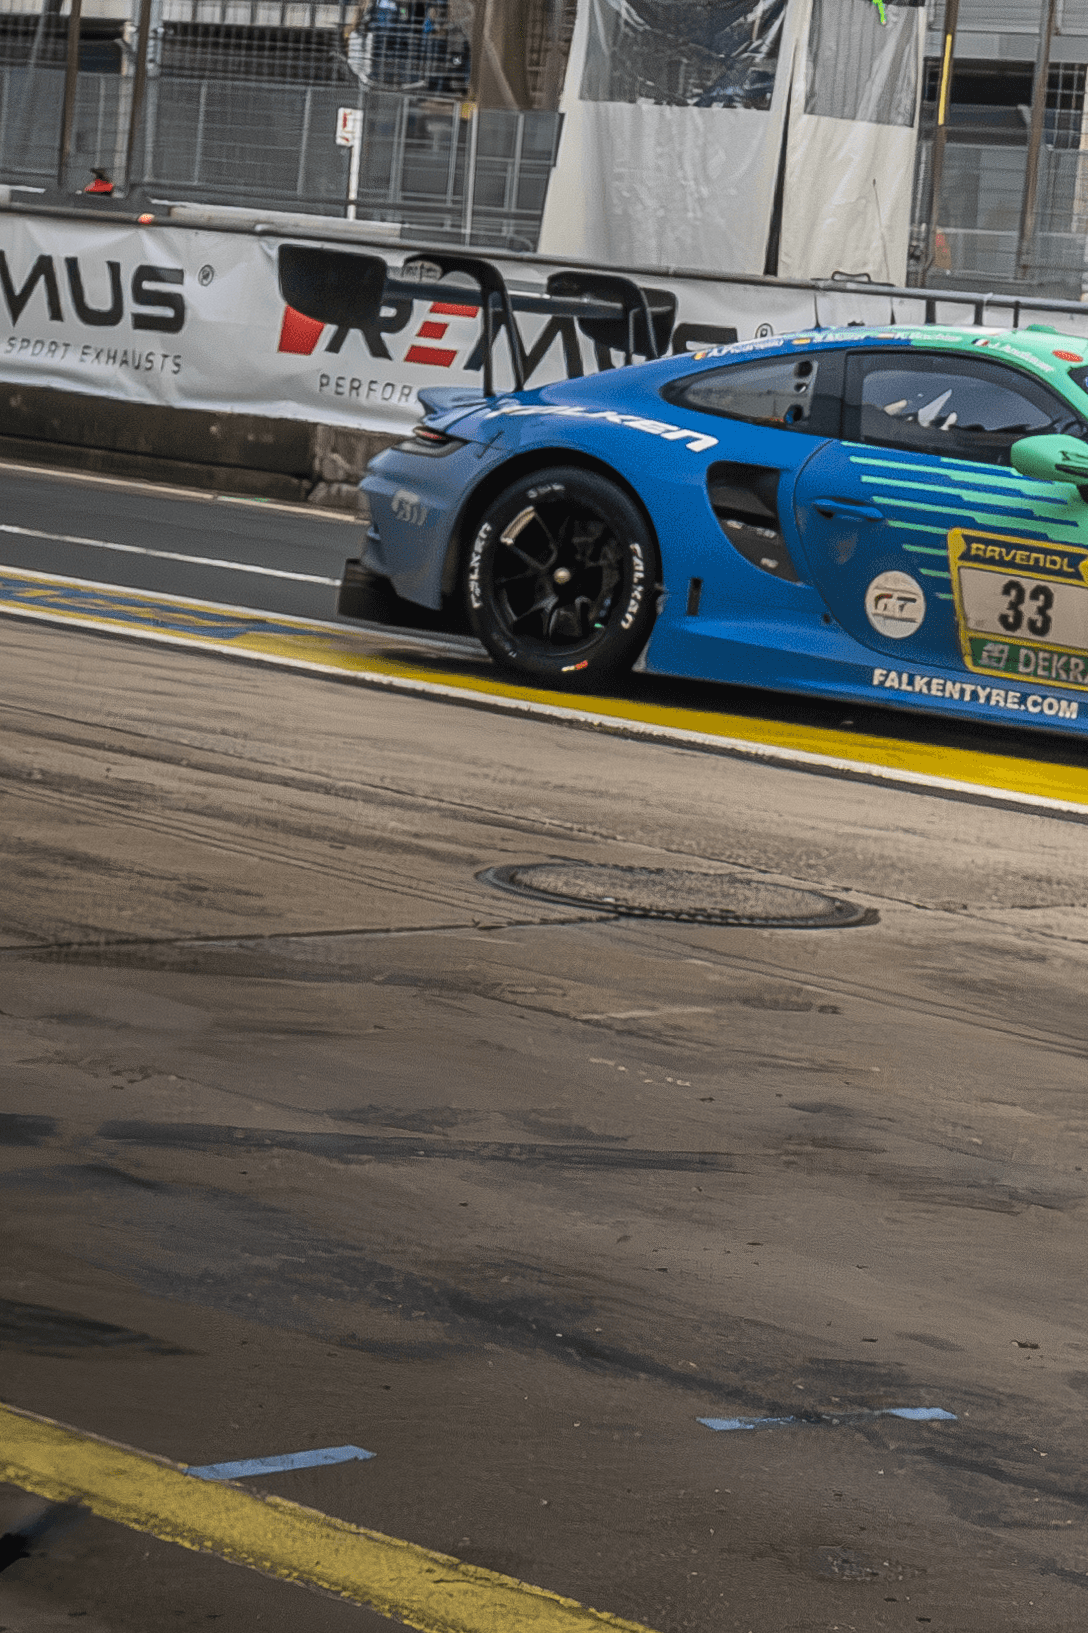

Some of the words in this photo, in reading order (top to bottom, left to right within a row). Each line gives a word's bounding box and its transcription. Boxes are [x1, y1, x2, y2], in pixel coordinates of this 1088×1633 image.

[4, 336, 71, 359] SPORT
[79, 344, 183, 375] EXHAUSTS
[317, 372, 417, 404] PERFOR
[969, 541, 1077, 574] RAVENOL
[998, 579, 1055, 638] 33
[871, 667, 1080, 720] FALKENTYRE.COM
